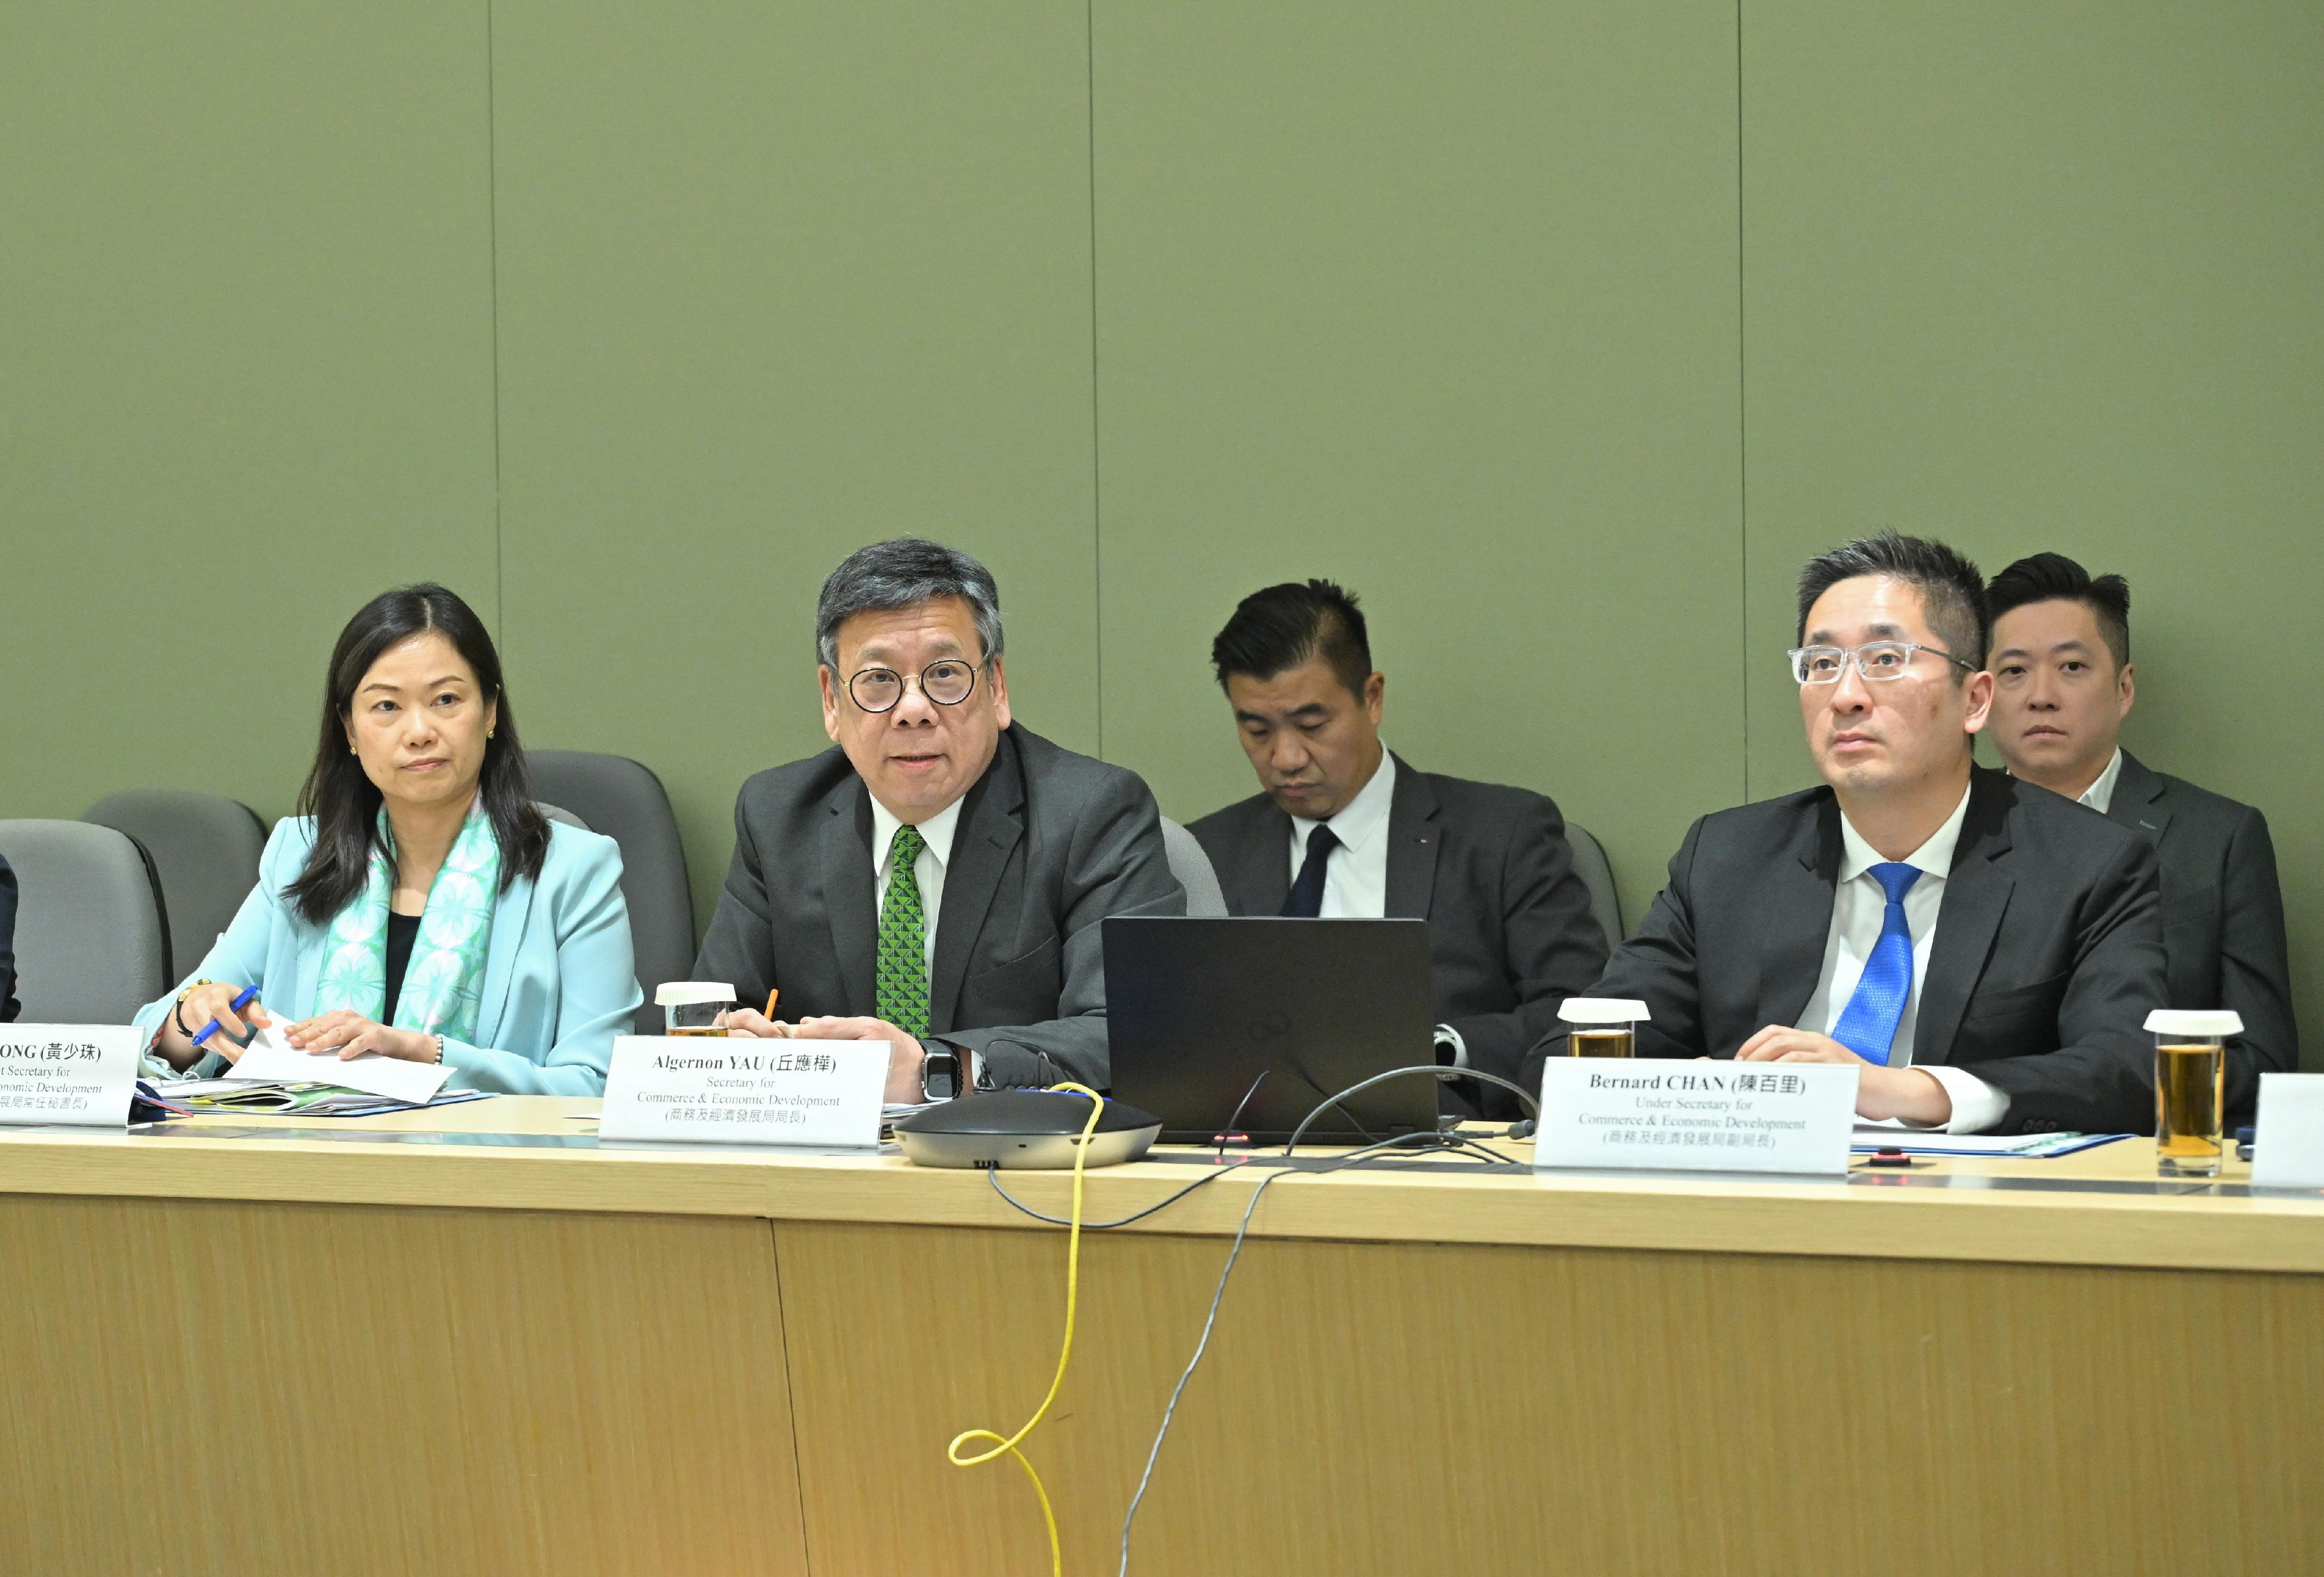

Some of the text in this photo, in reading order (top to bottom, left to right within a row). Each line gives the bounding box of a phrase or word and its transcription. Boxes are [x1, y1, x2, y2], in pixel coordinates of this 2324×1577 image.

[652, 1053, 837, 1074] Algernon YAU (丘應樺)
[8, 1066, 53, 1079] Secretary
[57, 1066, 71, 1077] for
[37, 1083, 102, 1095] Development
[706, 1077, 776, 1090] Secretary for
[1590, 1074, 1660, 1089] Bernard
[1667, 1075, 1726, 1091] CHAN
[637, 1091, 840, 1108] Commerce & Economic Development
[1636, 1096, 1753, 1113] Under Secretary for
[1579, 1113, 1806, 1131] Commerce & Economic Development
